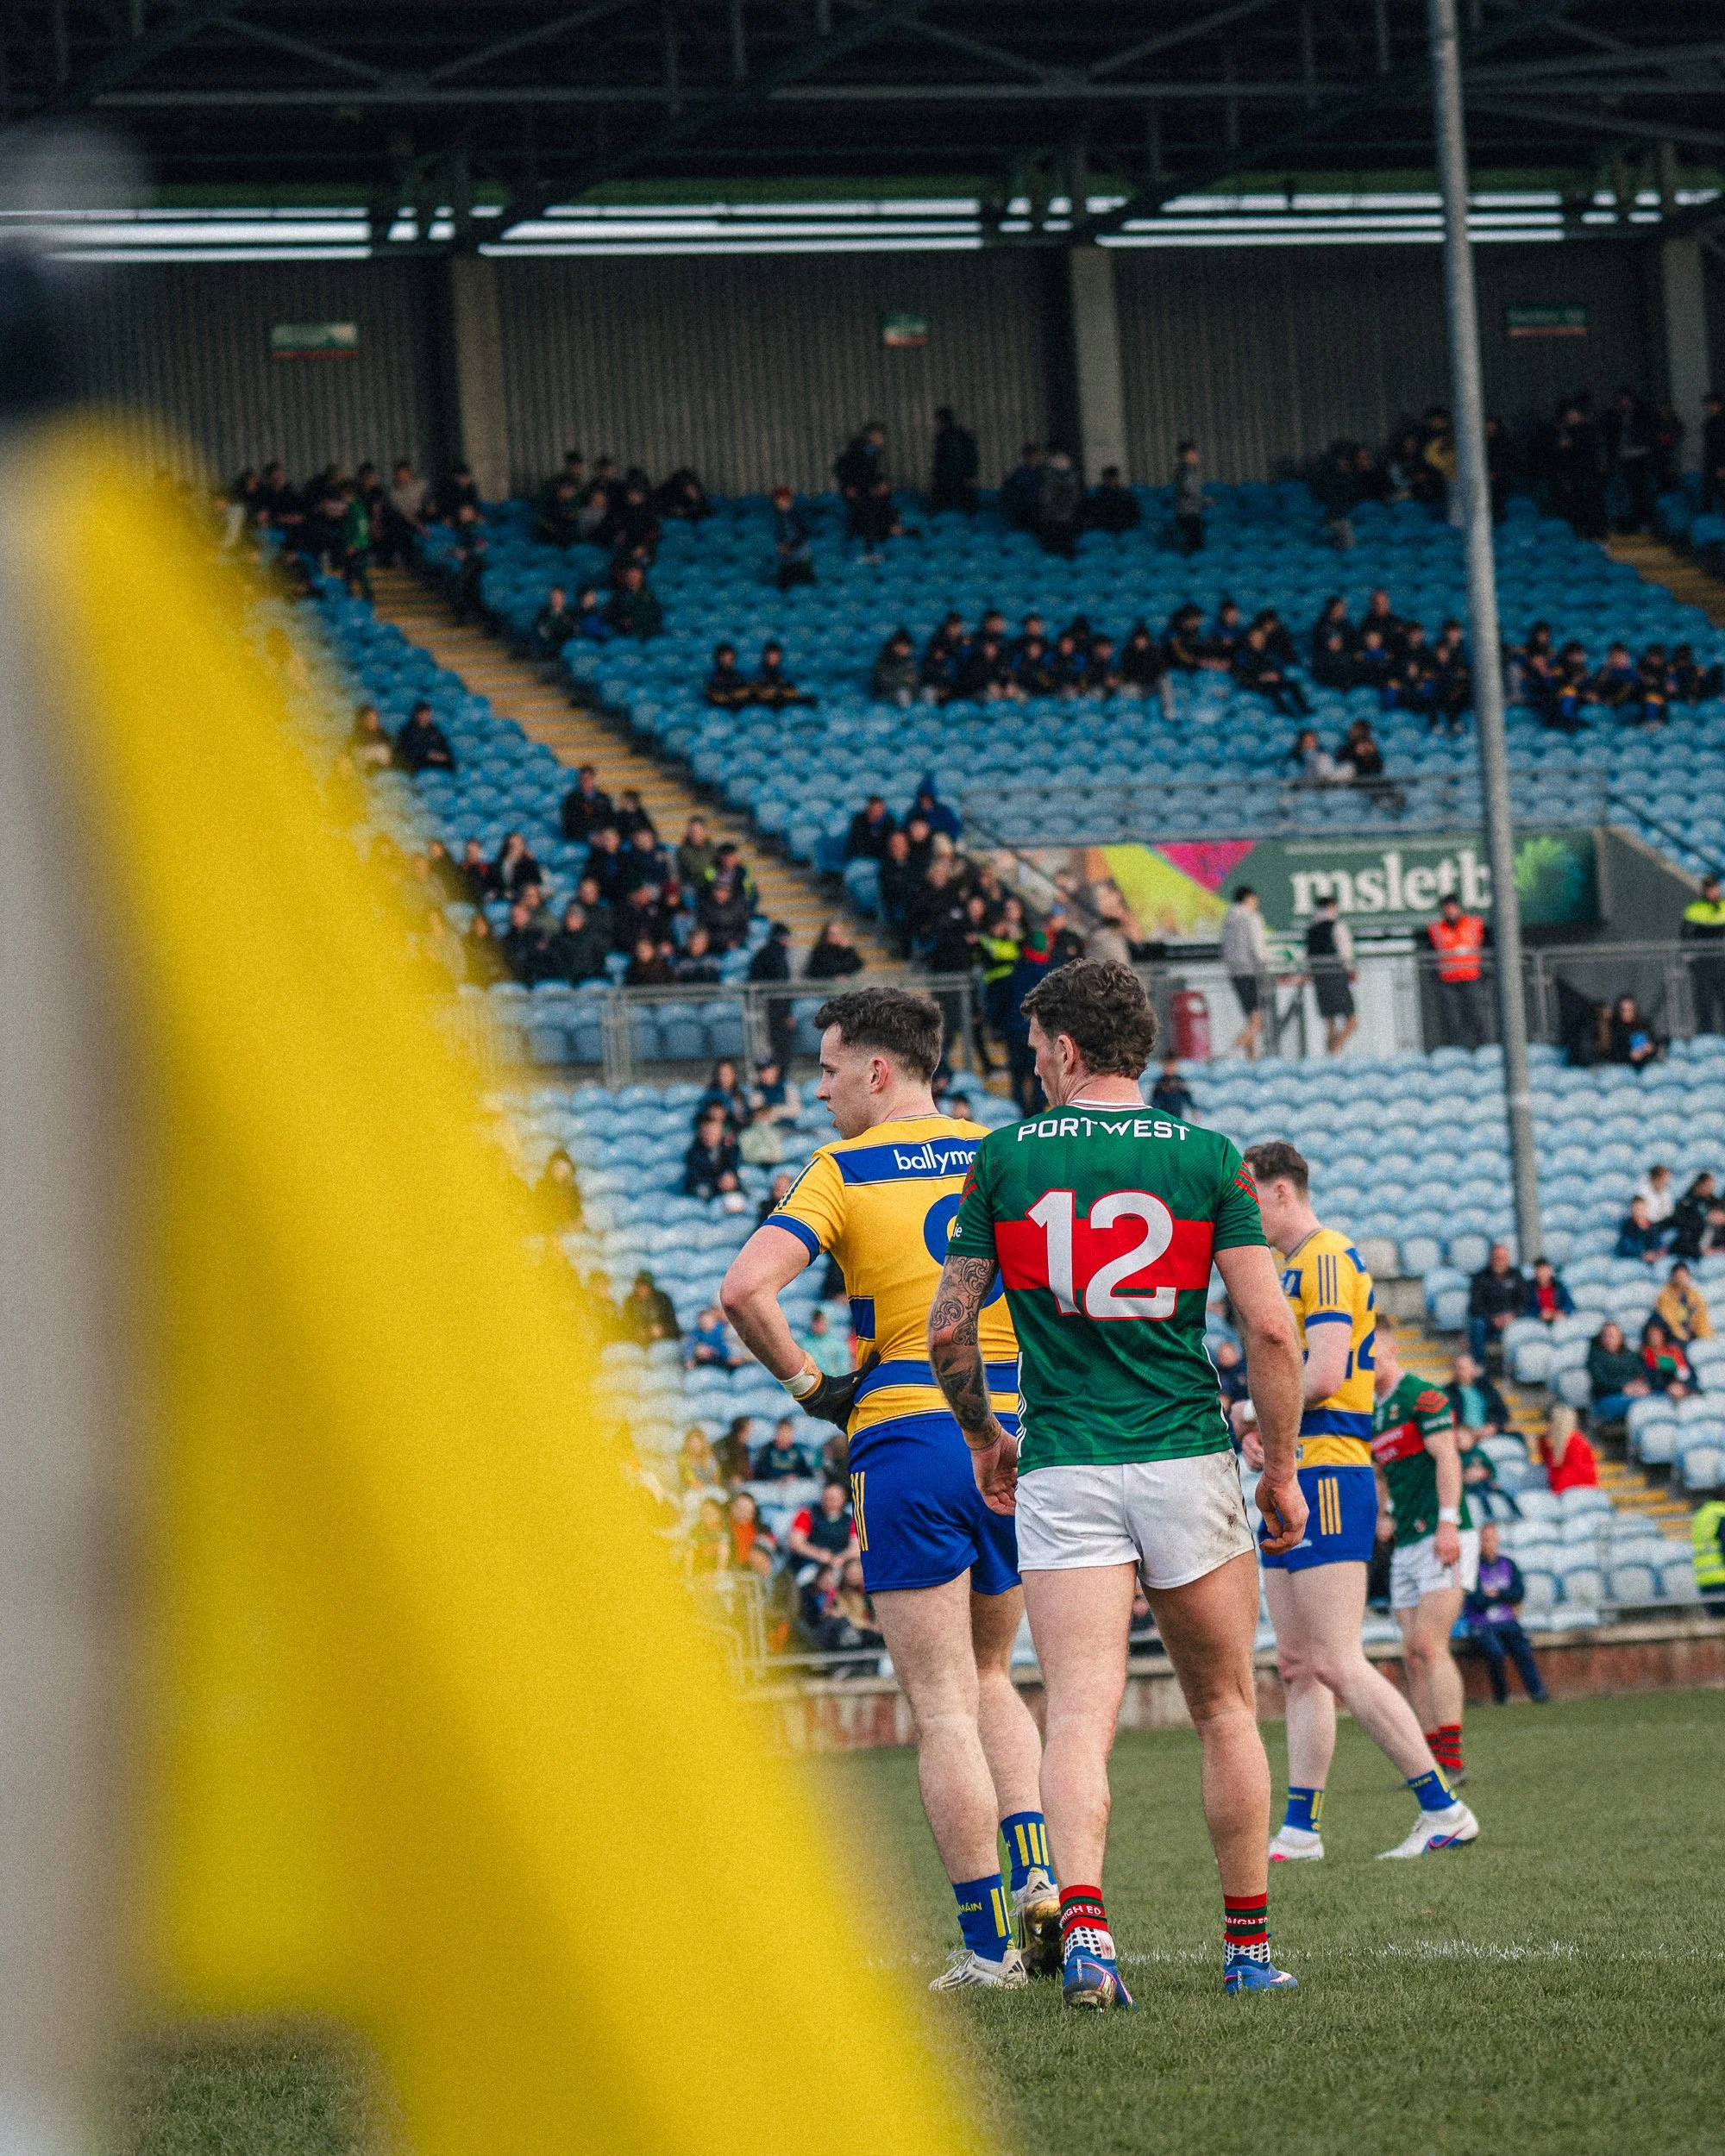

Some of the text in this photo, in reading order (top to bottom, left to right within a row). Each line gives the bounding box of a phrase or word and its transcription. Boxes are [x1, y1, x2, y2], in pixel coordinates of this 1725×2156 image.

[1017, 1117, 1190, 1142] PORTWEST
[1025, 1188, 1178, 1321] 12
[1086, 1905, 1101, 1915] EO
